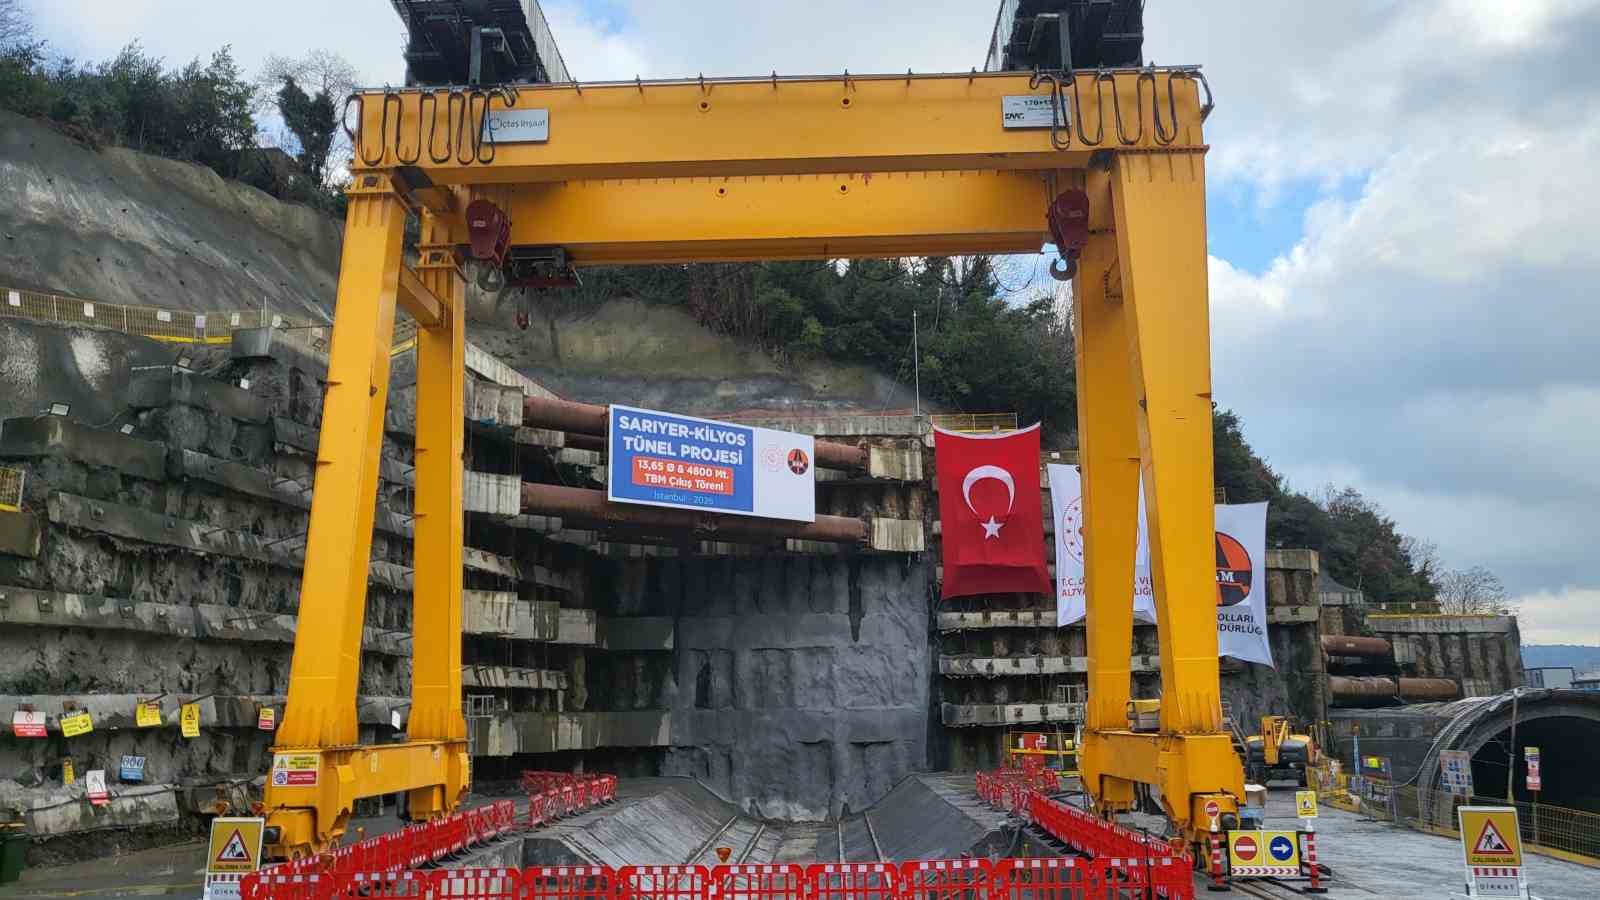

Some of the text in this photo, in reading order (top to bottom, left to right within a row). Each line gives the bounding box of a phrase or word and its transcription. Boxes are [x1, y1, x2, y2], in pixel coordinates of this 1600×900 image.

[619, 415, 746, 446] SARIYER-KİLYOS
[623, 435, 742, 465] TÜNEL PROJESİ
[637, 459, 664, 472] 13,65
[677, 464, 685, 473] &
[686, 465, 713, 477] 4800
[644, 473, 667, 484] TBM
[668, 476, 692, 489] Çıkış
[1217, 612, 1254, 623] OLLARI
